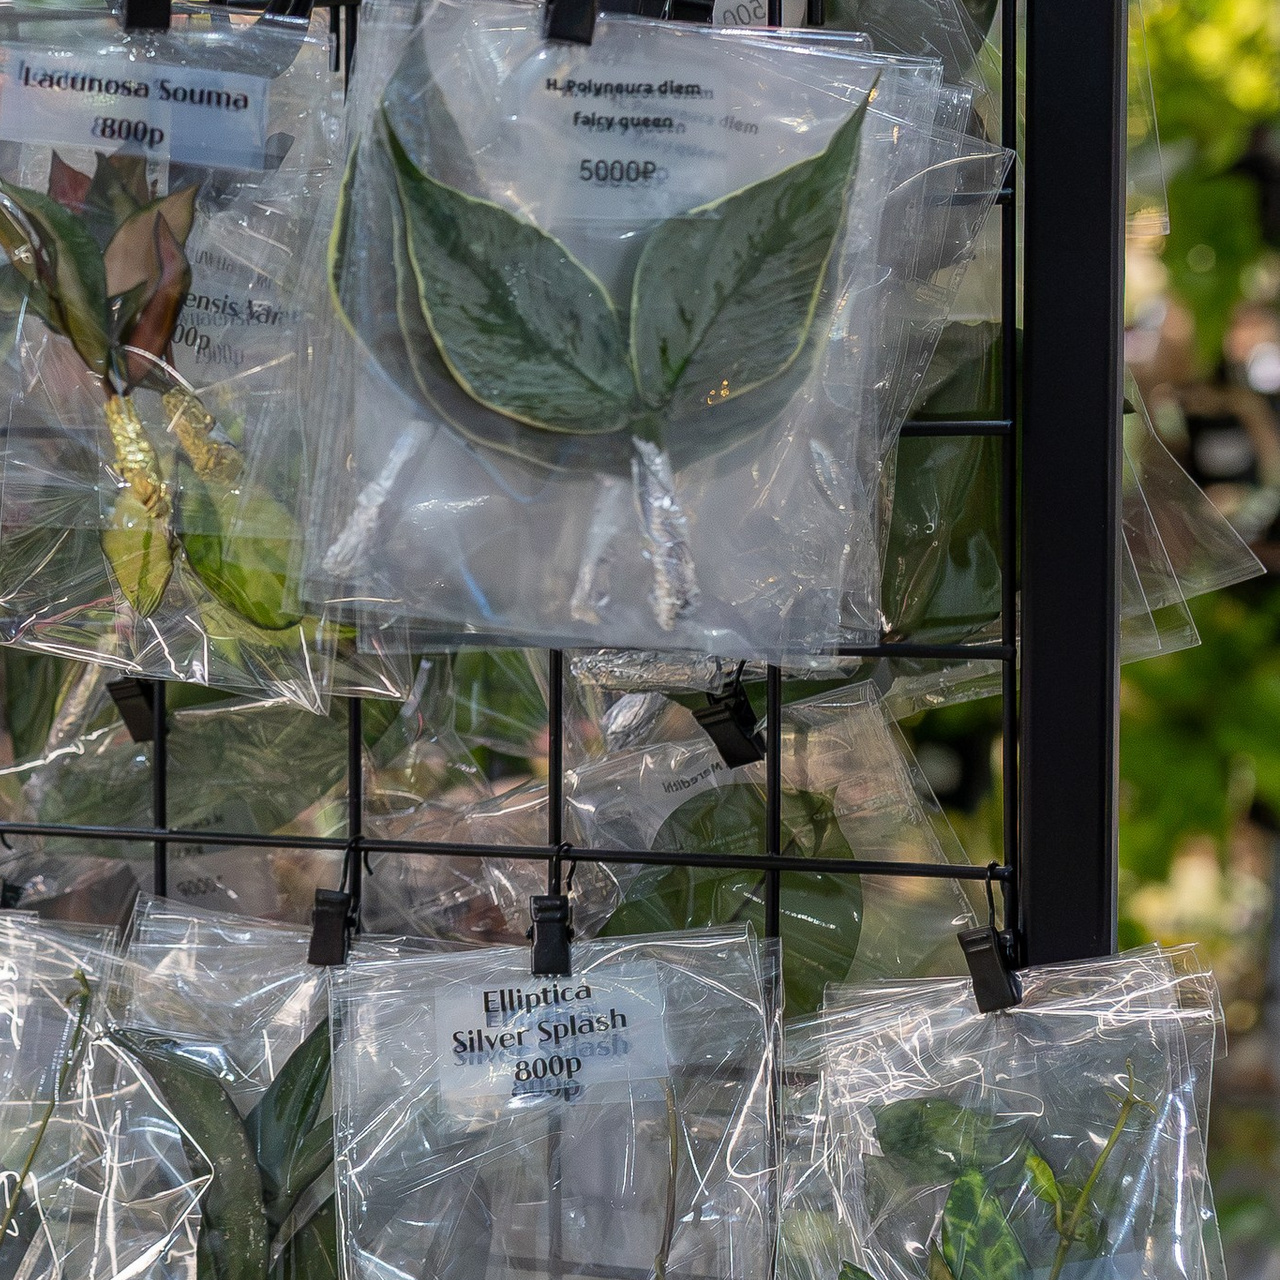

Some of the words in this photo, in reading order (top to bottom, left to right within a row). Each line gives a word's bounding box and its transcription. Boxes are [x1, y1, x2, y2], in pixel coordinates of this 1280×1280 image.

[22, 66, 150, 99] Lacunosa
[158, 78, 249, 111] Souma
[565, 78, 655, 97] Polyneura
[100, 117, 164, 150] 800p
[578, 159, 657, 182] 5000₽
[482, 983, 592, 1014] Elliptica
[452, 1027, 530, 1054] Silver
[537, 1008, 628, 1045] Splash
[514, 1054, 582, 1082] 800p
